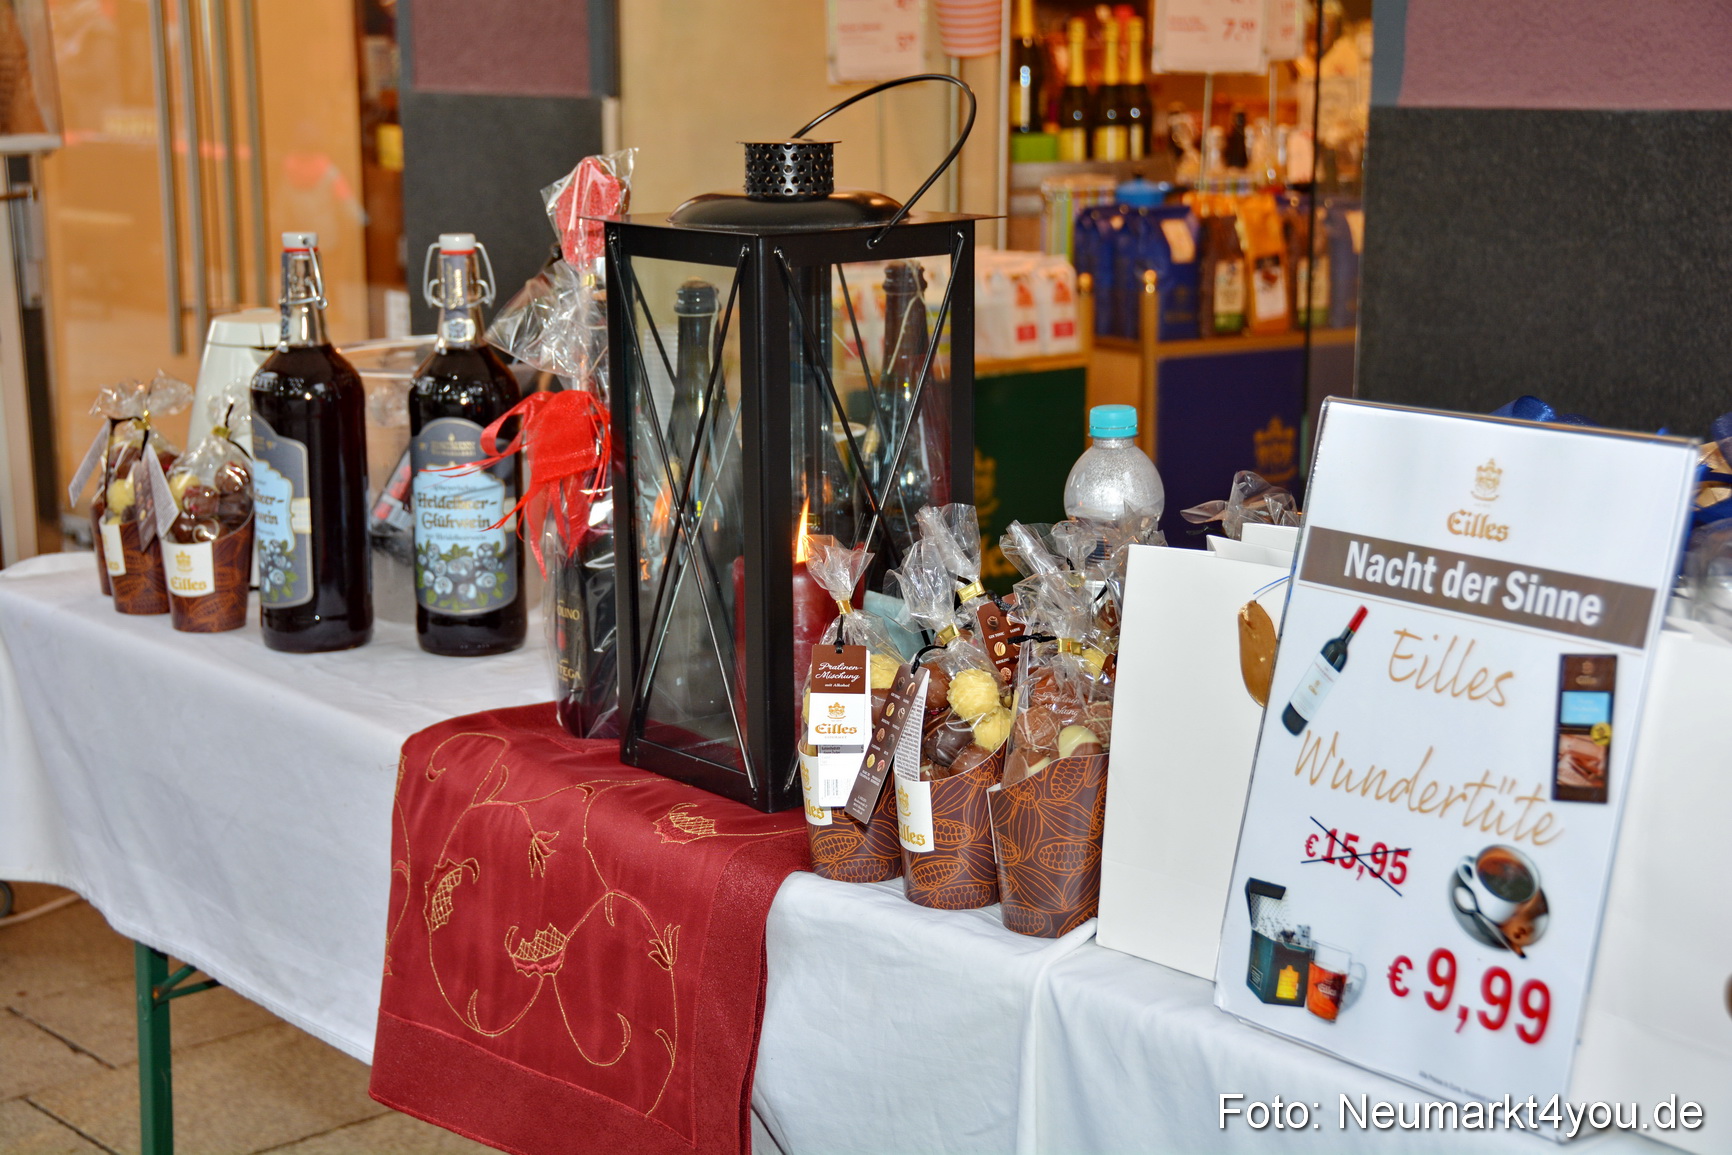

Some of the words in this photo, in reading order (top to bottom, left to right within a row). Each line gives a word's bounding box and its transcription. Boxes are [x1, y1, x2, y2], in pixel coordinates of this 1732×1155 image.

[417, 492, 498, 510] Heidelbeer-
[422, 511, 490, 530] Glühwein
[1447, 509, 1510, 542] Eilles
[1344, 540, 1437, 594] Nacht
[1441, 560, 1498, 605] der
[1501, 570, 1602, 626] Sinne
[558, 663, 581, 680] TEGA
[815, 671, 861, 683] Mischung
[1388, 628, 1514, 707] Eilles
[814, 722, 858, 735] Eilles
[1295, 729, 1564, 846] Wundertüte
